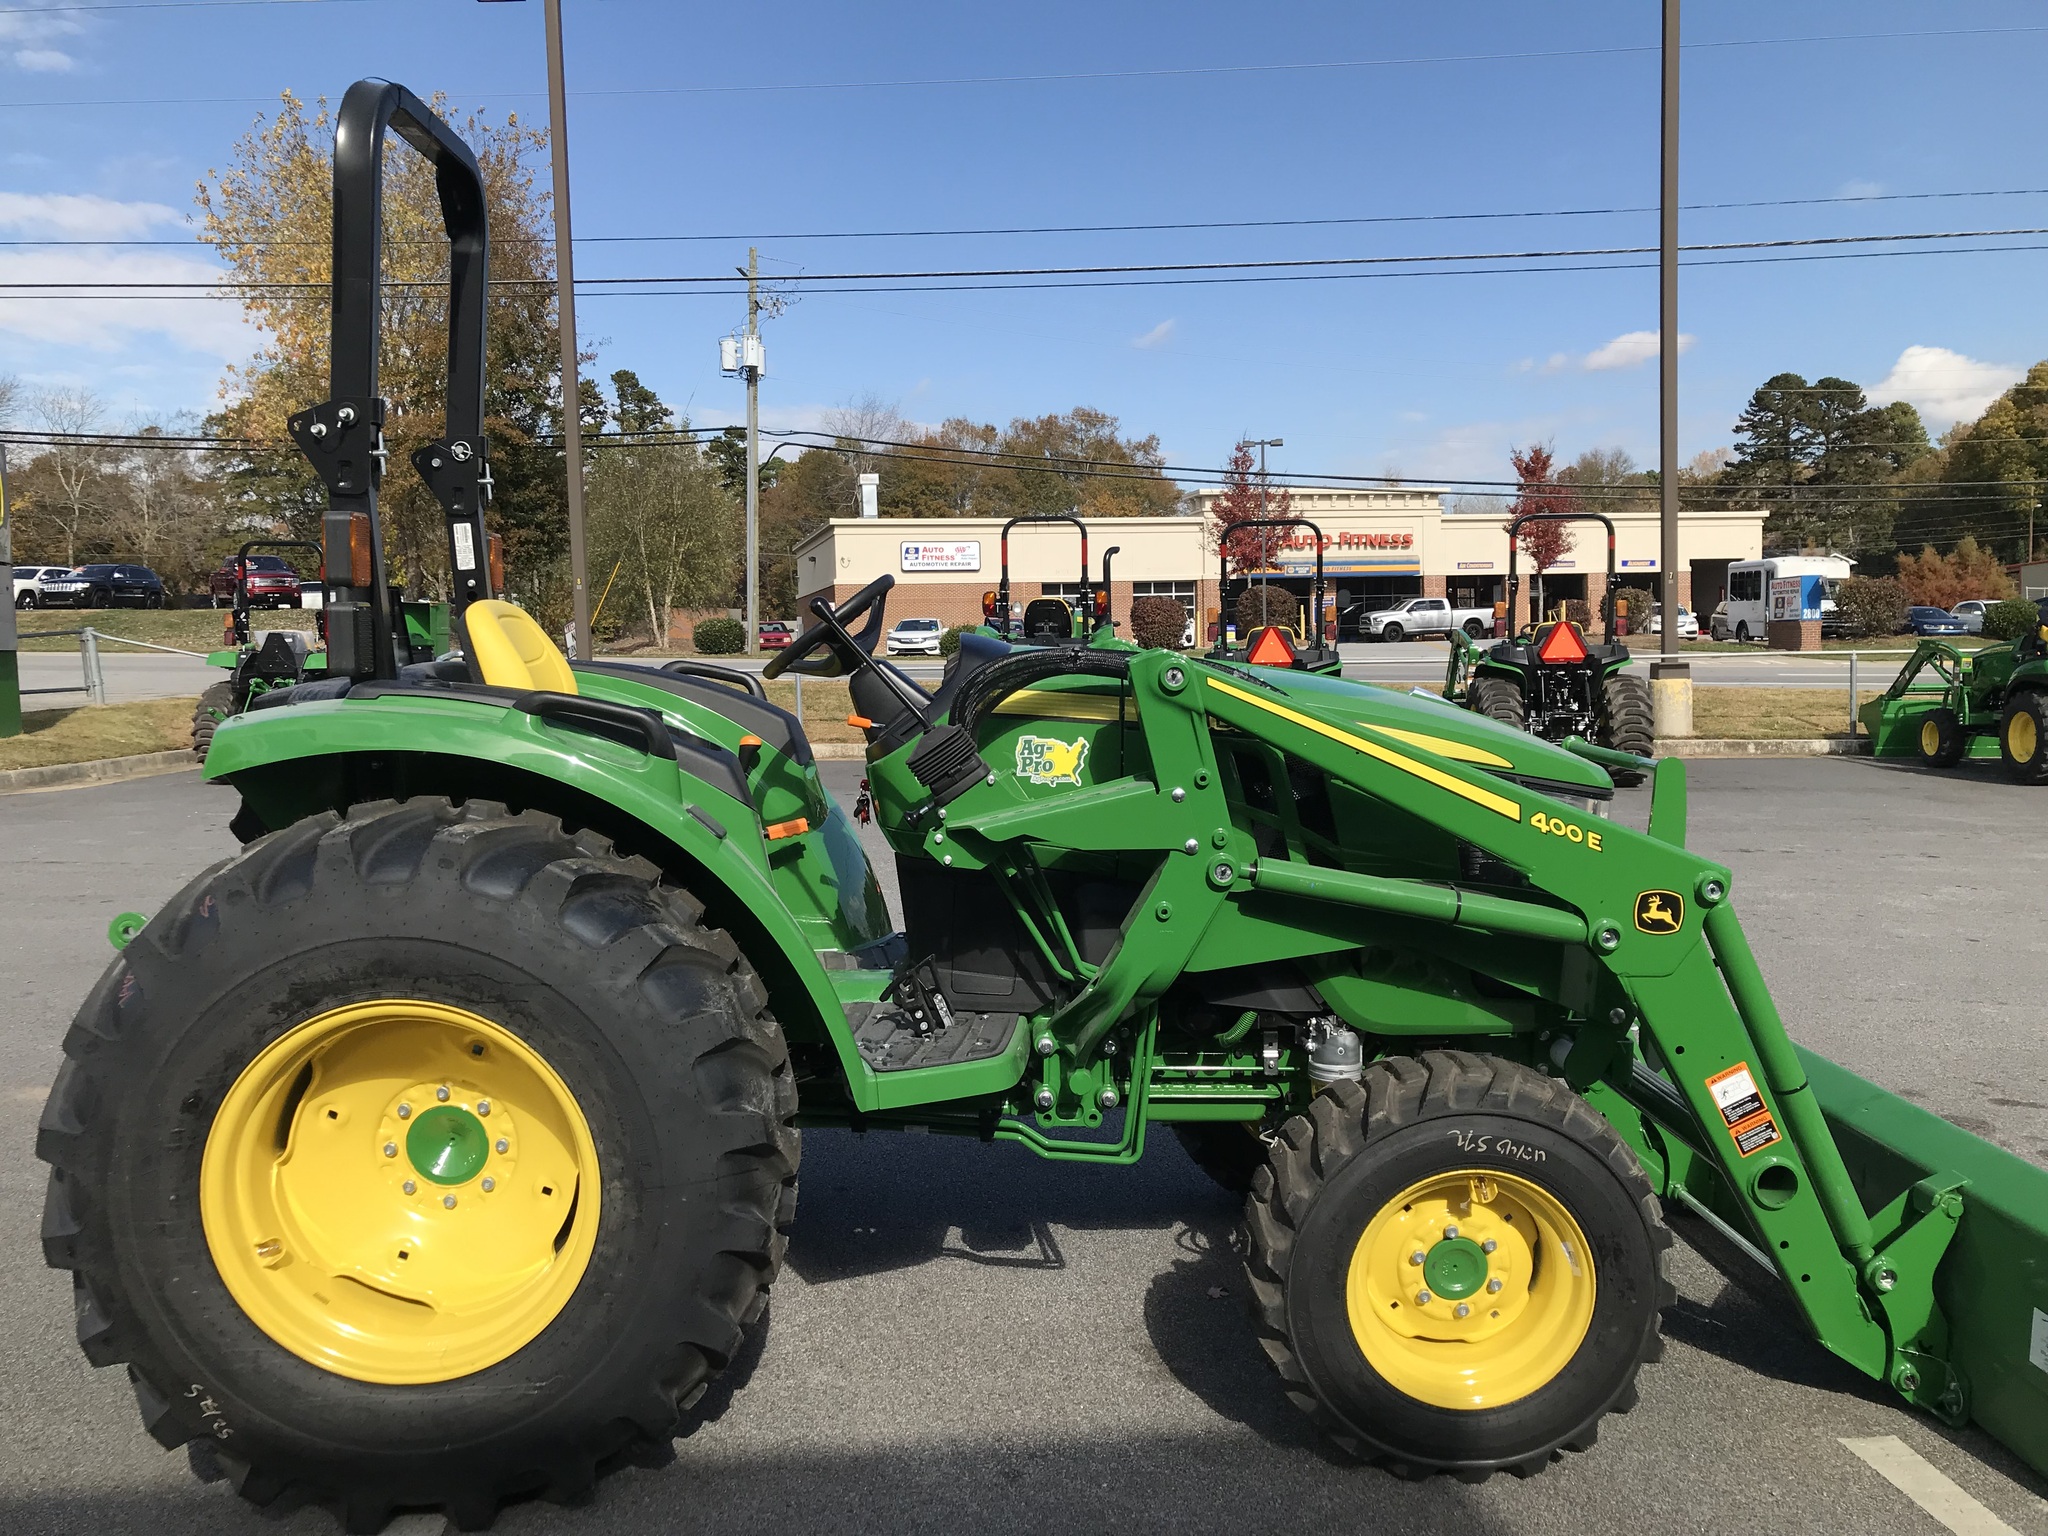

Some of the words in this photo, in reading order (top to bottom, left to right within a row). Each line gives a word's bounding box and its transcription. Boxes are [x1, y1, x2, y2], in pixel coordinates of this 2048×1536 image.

[1281, 534, 1333, 548] AUTO
[1339, 532, 1414, 547] FITNESS
[1020, 757, 1053, 773] Pro
[1717, 1065, 1743, 1081] WARNING
[1741, 1115, 1768, 1131] WARNING
